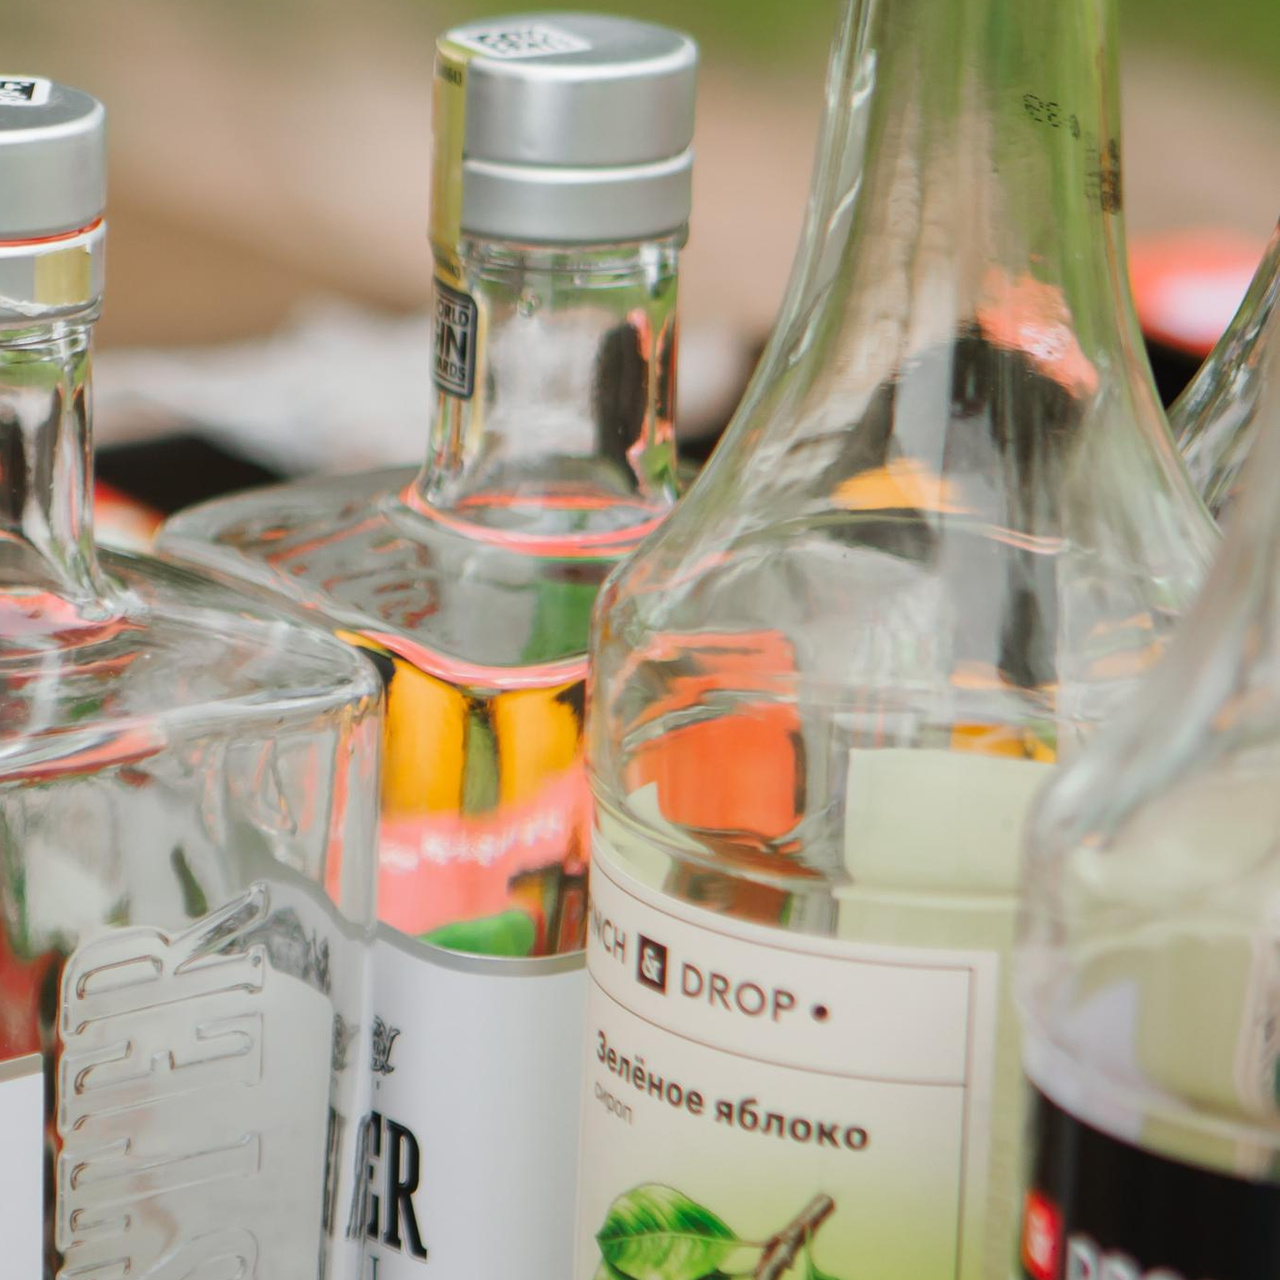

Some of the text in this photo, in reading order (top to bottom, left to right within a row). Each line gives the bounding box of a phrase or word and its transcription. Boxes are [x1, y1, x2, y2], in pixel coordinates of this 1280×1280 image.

[439, 300, 470, 327] ORLD
[680, 961, 797, 1023] DROP
[595, 1029, 871, 1152] Зелёное яблоко
